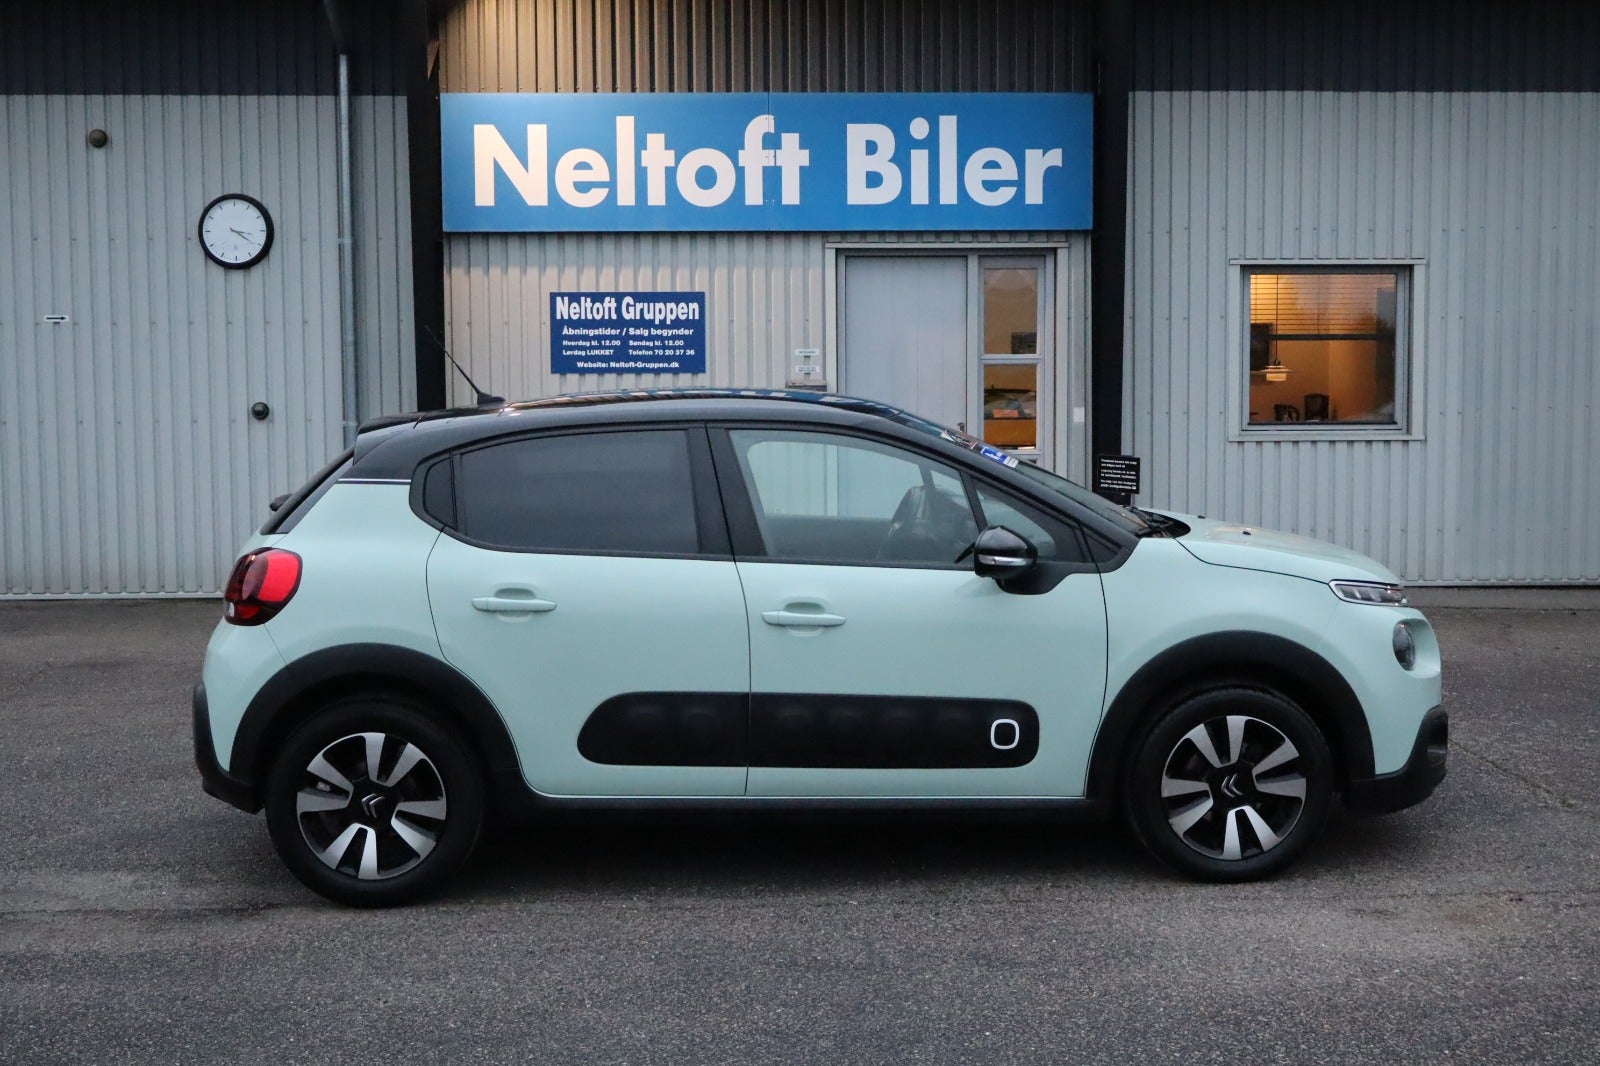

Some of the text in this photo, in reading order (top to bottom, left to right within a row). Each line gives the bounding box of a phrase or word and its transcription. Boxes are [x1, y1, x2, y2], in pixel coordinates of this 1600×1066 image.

[472, 114, 1064, 209] Neltoft Biler
[556, 296, 699, 324] Neltoft Gruppen
[563, 326, 620, 337] Åbningstider
[629, 328, 649, 337] Salg
[651, 328, 693, 337] begynder
